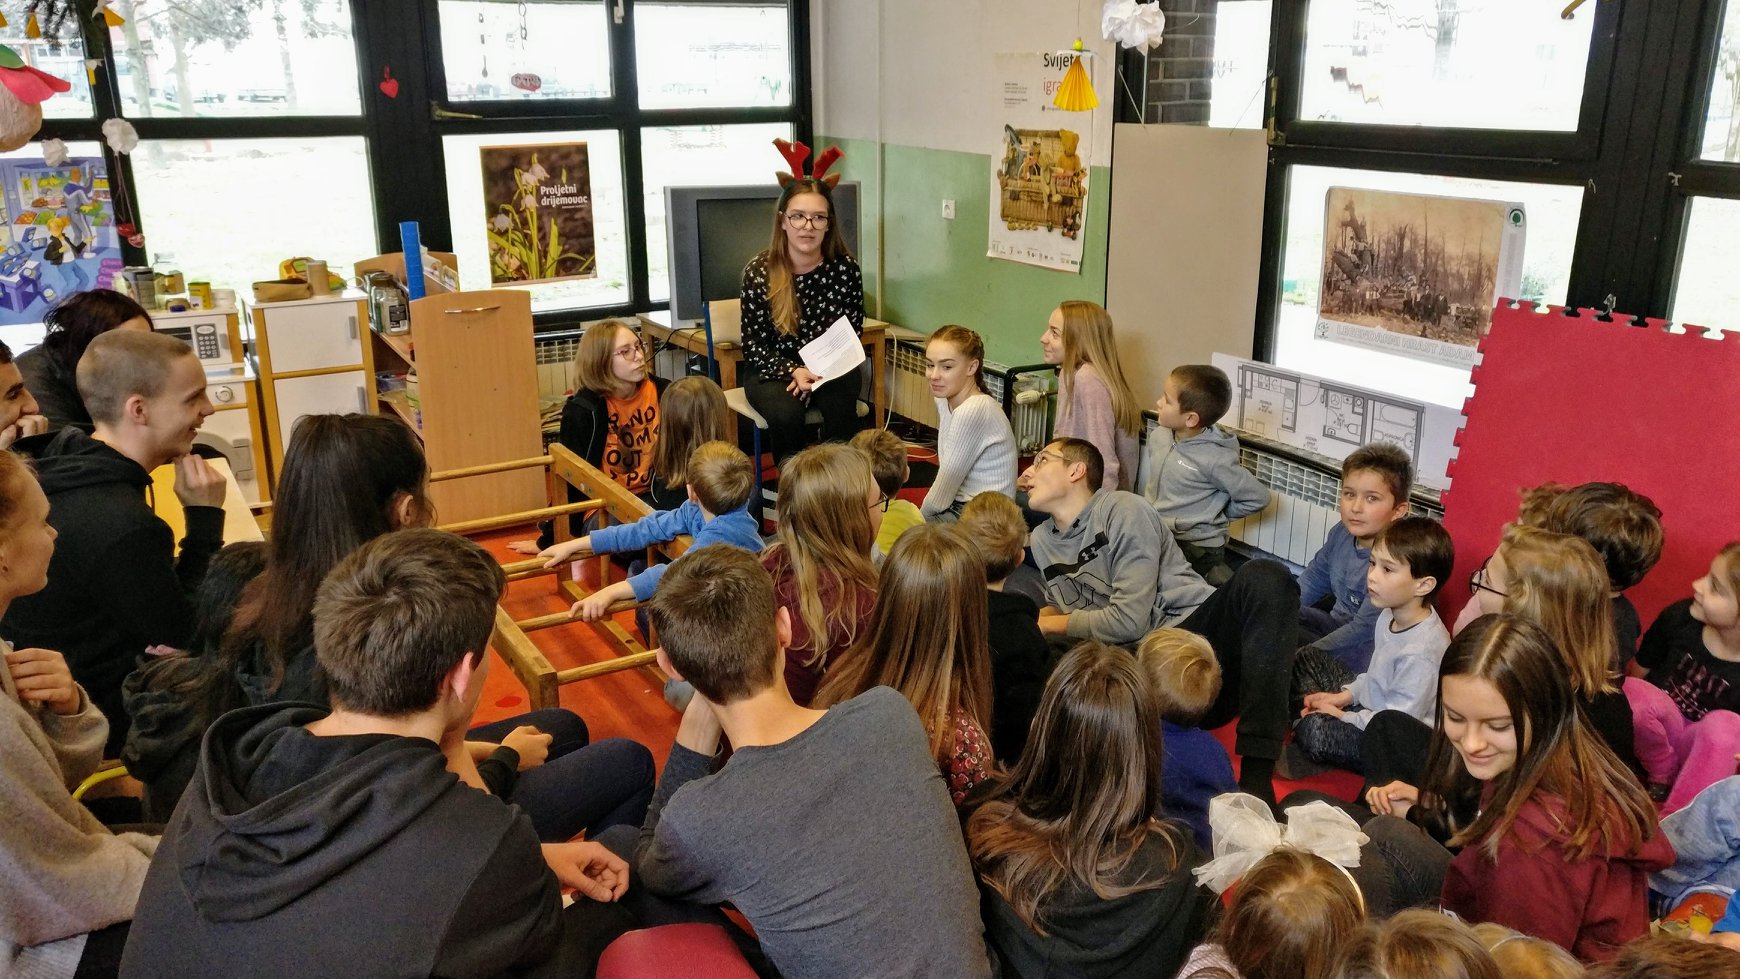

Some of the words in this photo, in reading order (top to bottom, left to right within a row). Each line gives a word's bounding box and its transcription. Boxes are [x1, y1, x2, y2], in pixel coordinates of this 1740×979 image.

[1043, 77, 1063, 95] igra
[540, 184, 577, 196] Proljetni
[541, 195, 588, 208] drijemovac
[606, 449, 642, 467] OUT
